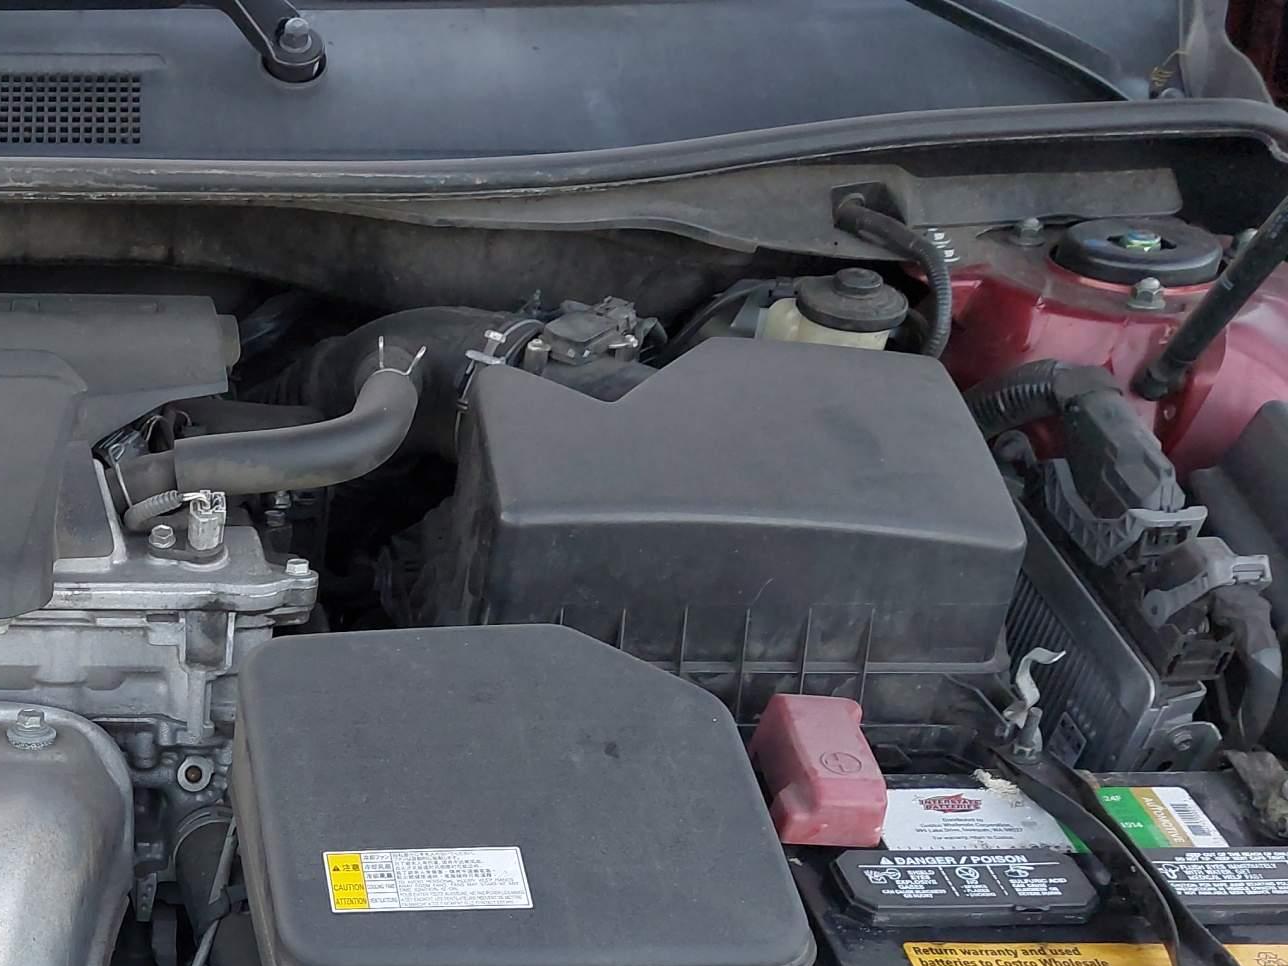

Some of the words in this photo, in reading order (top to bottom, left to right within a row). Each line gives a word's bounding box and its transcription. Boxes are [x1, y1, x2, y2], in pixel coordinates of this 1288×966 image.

[1143, 796, 1186, 843] AUTOMOTIVE
[894, 856, 957, 866] DANGER
[959, 856, 968, 865] /
[970, 855, 1028, 865] POISON
[342, 863, 360, 872] 注意
[334, 883, 365, 891] CAUTION
[336, 897, 367, 905] ATTENTION
[912, 946, 959, 956] Return
[958, 948, 1018, 959] warranty
[1021, 946, 1047, 956] and
[1049, 946, 1081, 956] used
[918, 957, 978, 966] batteries
